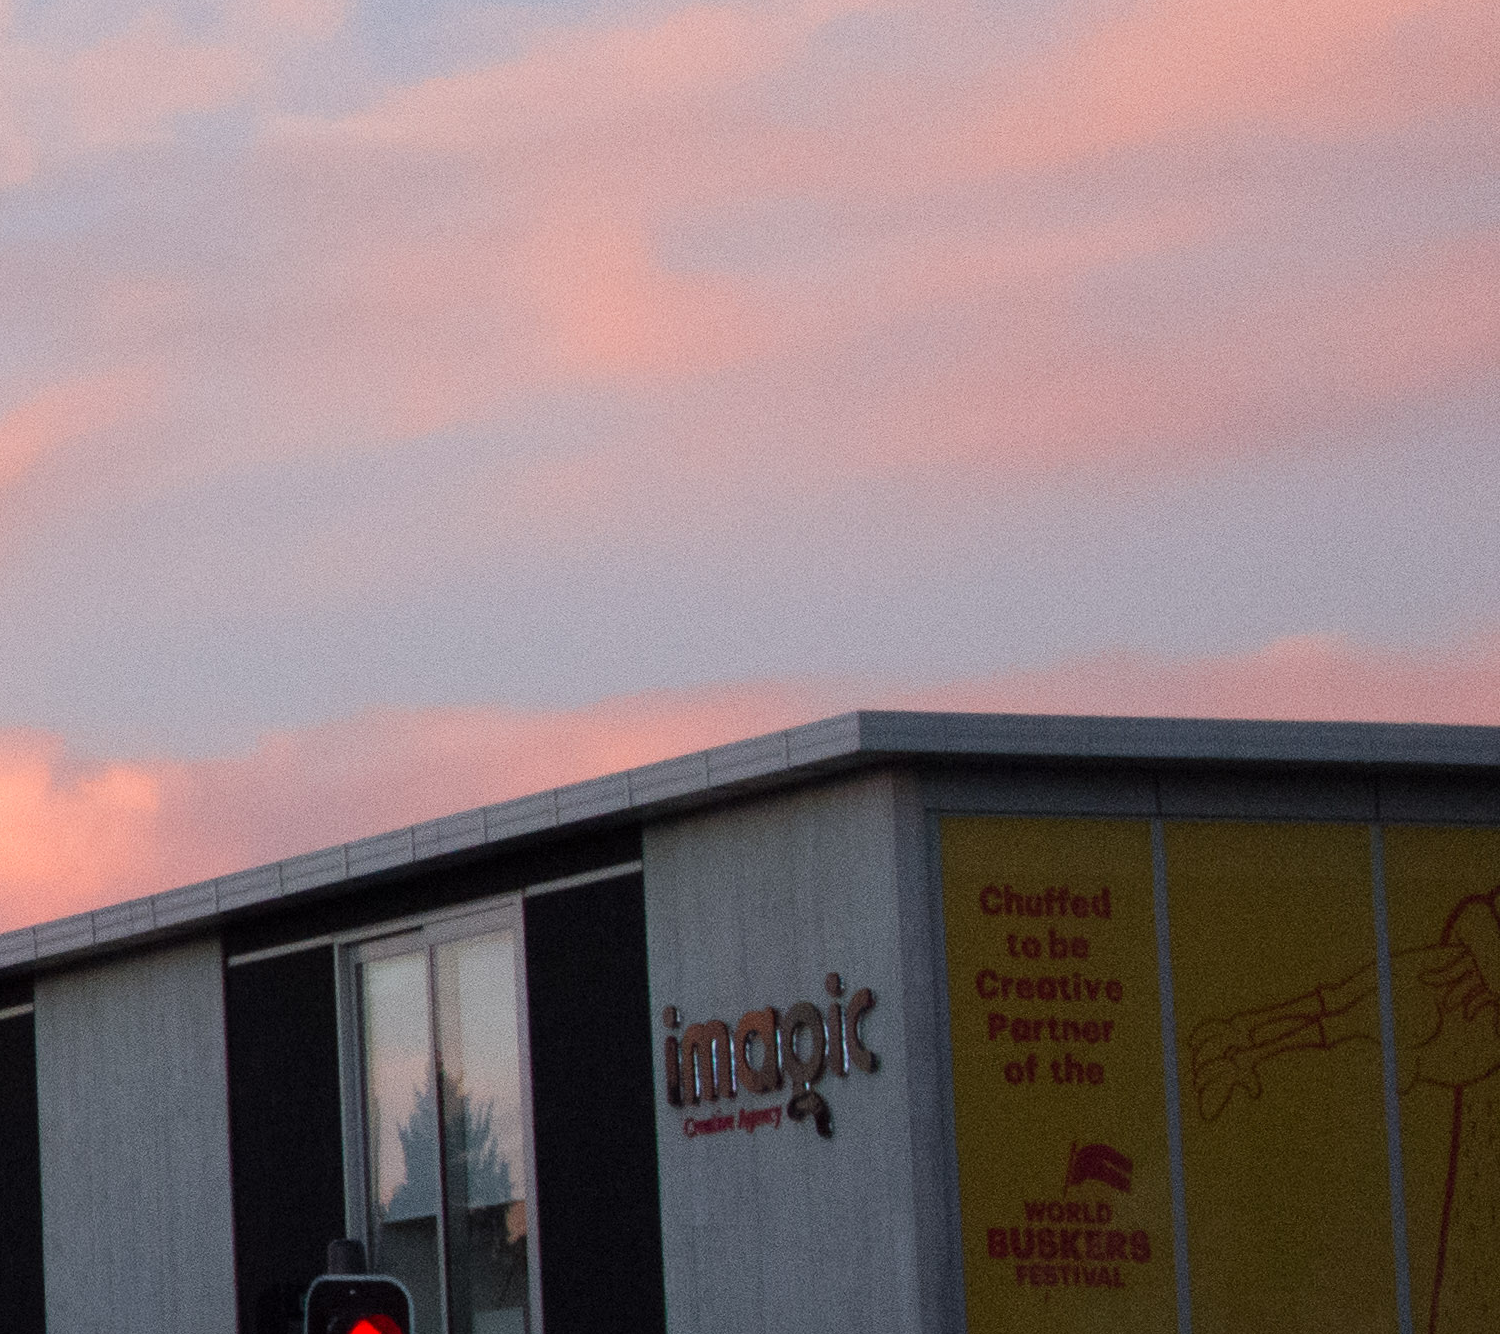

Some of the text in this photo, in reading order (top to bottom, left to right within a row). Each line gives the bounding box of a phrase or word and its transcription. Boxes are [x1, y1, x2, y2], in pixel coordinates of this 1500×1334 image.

[980, 884, 1111, 920] Chuffed
[1007, 928, 1089, 959] to be
[976, 969, 1123, 1003] Creative
[988, 1013, 1114, 1043] Partner
[1004, 1053, 1104, 1086] of the
[1024, 1200, 1113, 1224] WORLD
[987, 1227, 1151, 1263] BUSKERS
[1015, 1264, 1126, 1288] FESTIVAL
